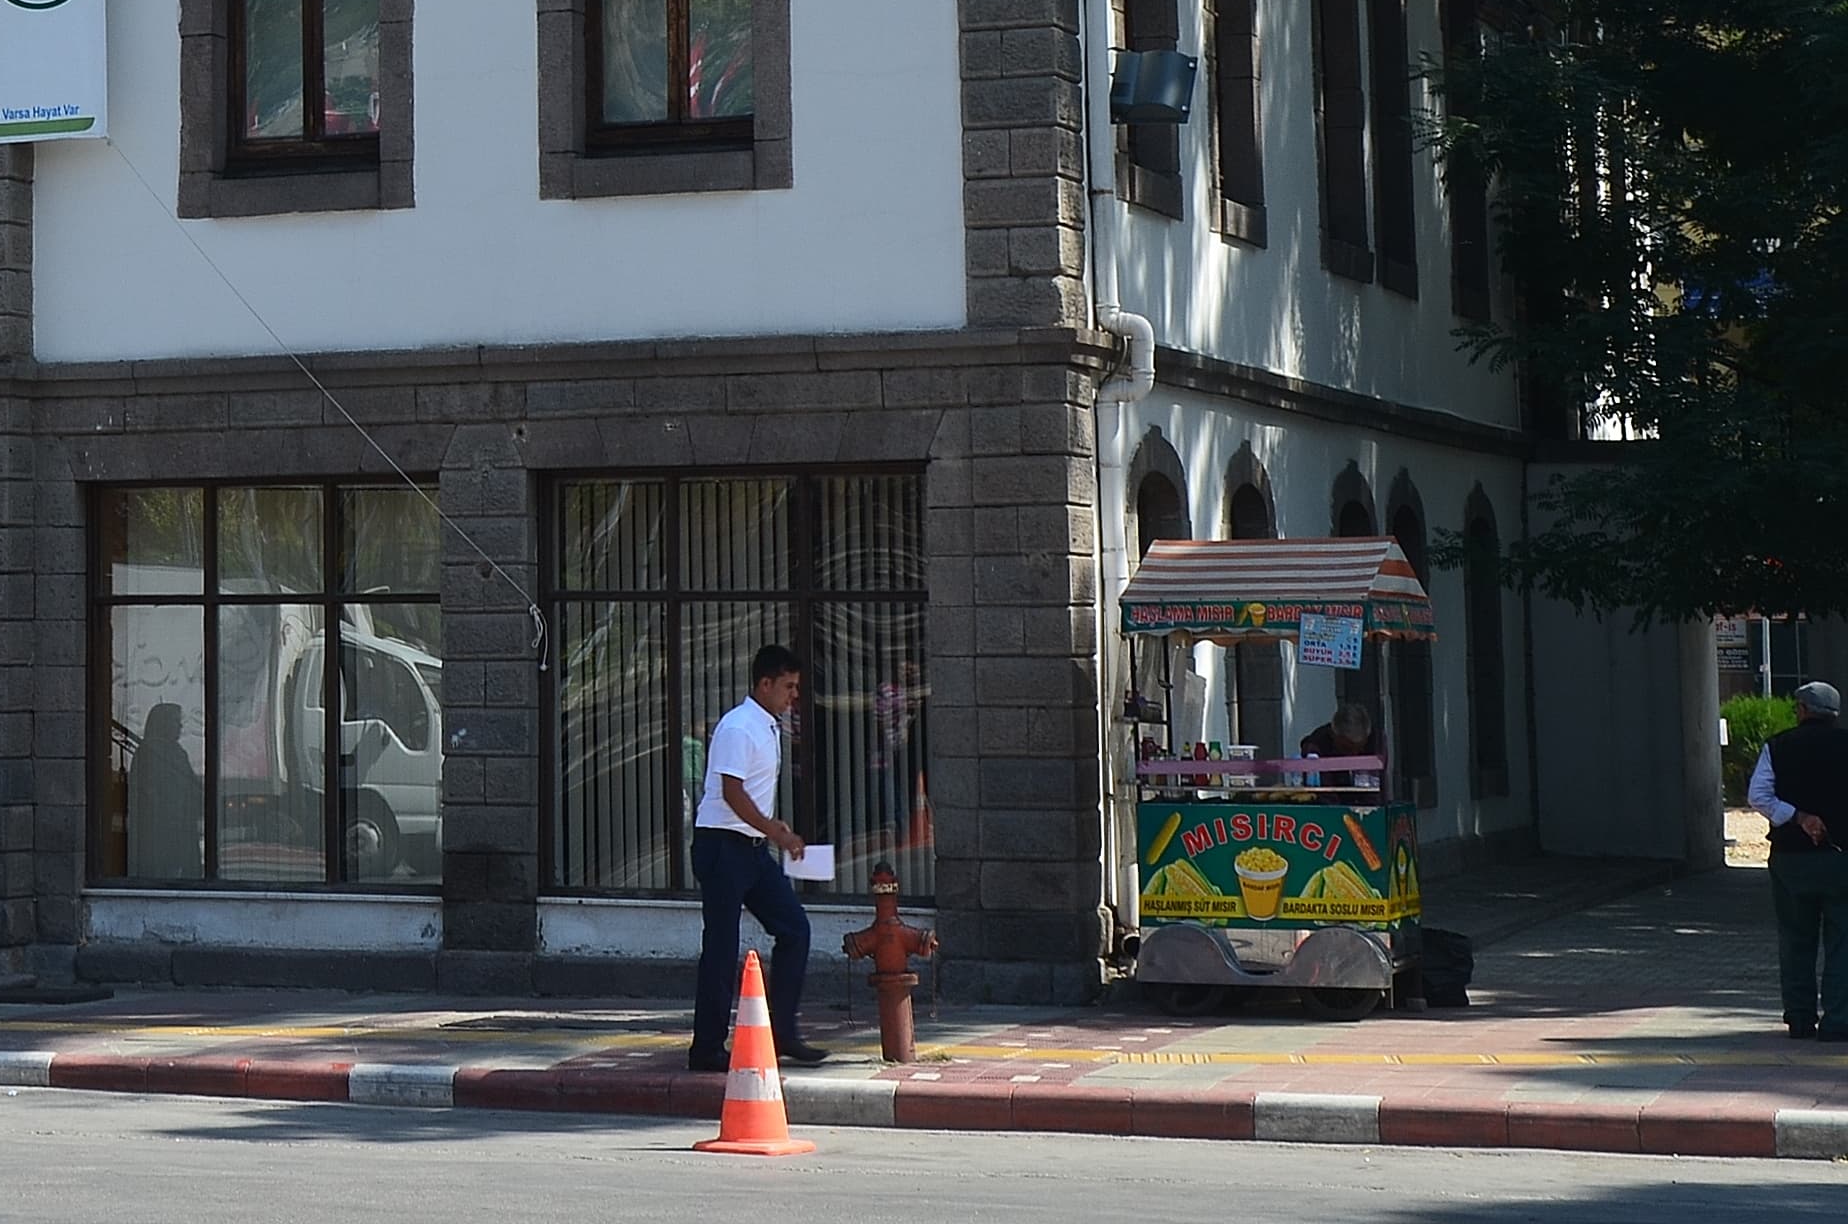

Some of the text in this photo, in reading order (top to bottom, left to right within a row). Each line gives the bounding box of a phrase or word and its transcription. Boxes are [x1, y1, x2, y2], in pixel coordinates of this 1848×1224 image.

[2, 108, 30, 119] Varsa
[33, 106, 61, 119] Hayat
[63, 104, 79, 116] Var
[1131, 603, 1234, 624] HAŞLAMA MISIR
[1181, 813, 1342, 861] MISIRCI
[1143, 897, 1236, 915] HAŞLANMIŞ SÜT MISIR
[1283, 901, 1327, 914] BARDAKTA
[1329, 902, 1358, 914] SOSLU
[1360, 902, 1385, 915] MISIR
